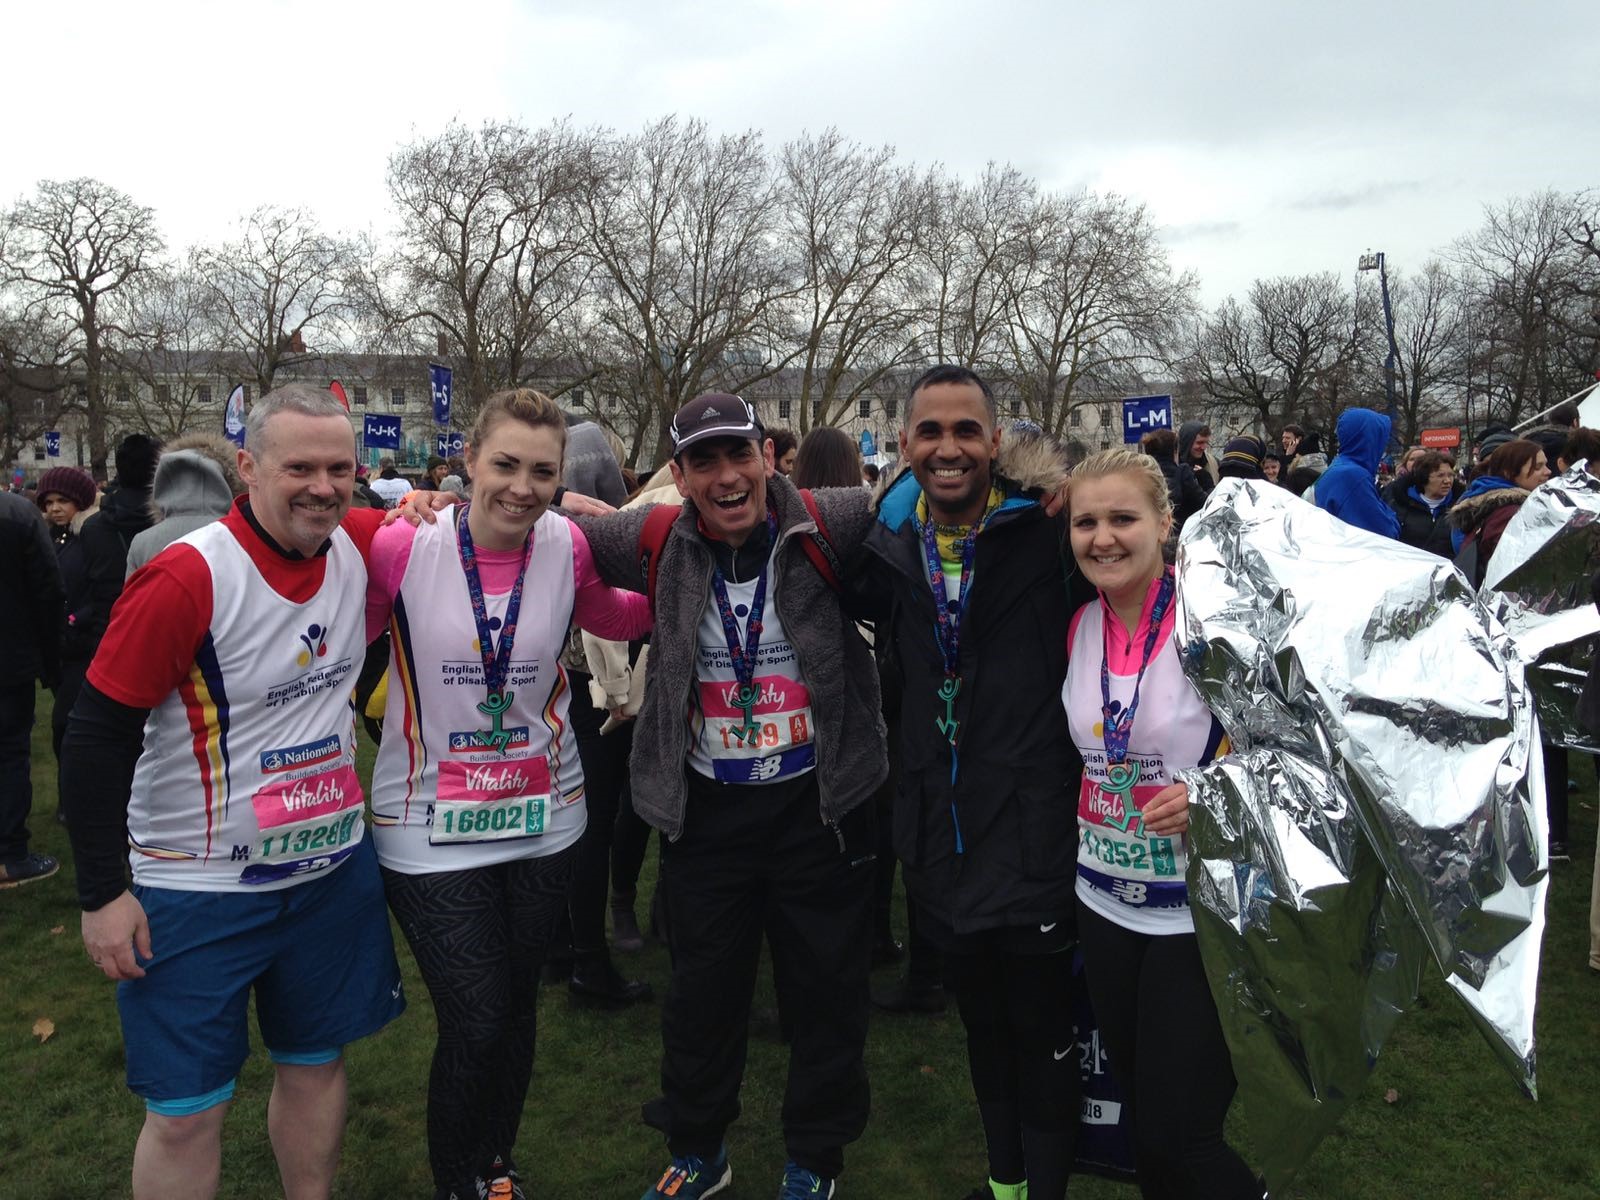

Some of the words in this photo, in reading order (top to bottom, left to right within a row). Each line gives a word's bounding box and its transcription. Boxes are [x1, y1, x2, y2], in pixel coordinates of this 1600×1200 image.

[1128, 409, 1167, 428] L-M
[367, 424, 397, 437] I-J-K
[438, 440, 463, 451] N-O
[767, 654, 797, 665] Sport
[442, 665, 482, 675] English
[443, 676, 454, 685] of
[457, 676, 508, 686] Disaby
[511, 676, 536, 686] Sport
[267, 680, 305, 700] English
[285, 741, 339, 764] Nationwide
[470, 754, 501, 762] Building
[1082, 753, 1104, 764] glish
[286, 769, 318, 781] Building
[465, 765, 529, 794] Vitality
[1140, 770, 1164, 782] port
[282, 778, 344, 812] Vitality
[1089, 784, 1125, 818] Vitali
[443, 806, 522, 833] 16802
[531, 802, 539, 813] G
[1081, 830, 1150, 869] 11352
